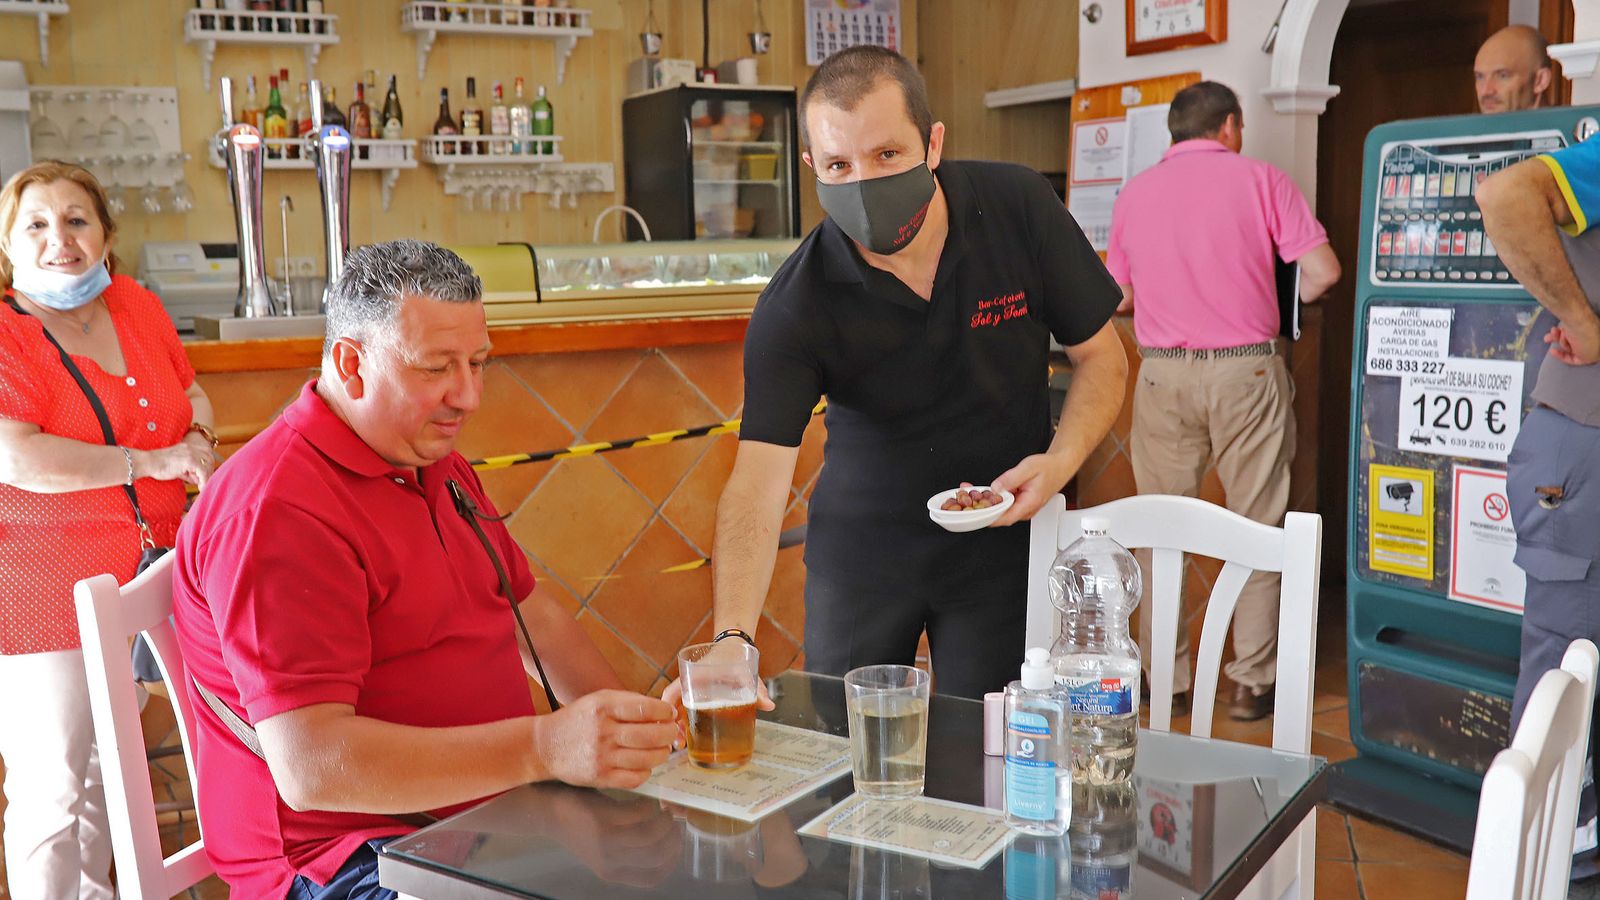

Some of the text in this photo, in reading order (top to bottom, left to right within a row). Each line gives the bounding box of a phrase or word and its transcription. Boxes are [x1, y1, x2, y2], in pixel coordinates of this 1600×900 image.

[1400, 310, 1420, 318] AIRE
[1372, 317, 1450, 329] ACONDICIONADO
[1393, 328, 1426, 337] AVERIAS
[1380, 337, 1407, 346] CARGA
[1377, 347, 1440, 358] INSTALACIONES
[1370, 357, 1446, 375] 686 333 227
[1457, 372, 1472, 388] BAJA
[1478, 373, 1487, 389] SU
[1487, 374, 1512, 391] COCHE?
[1413, 393, 1506, 435] 120 €
[1450, 438, 1506, 451] 639 282 610
[1018, 716, 1035, 724] GEL
